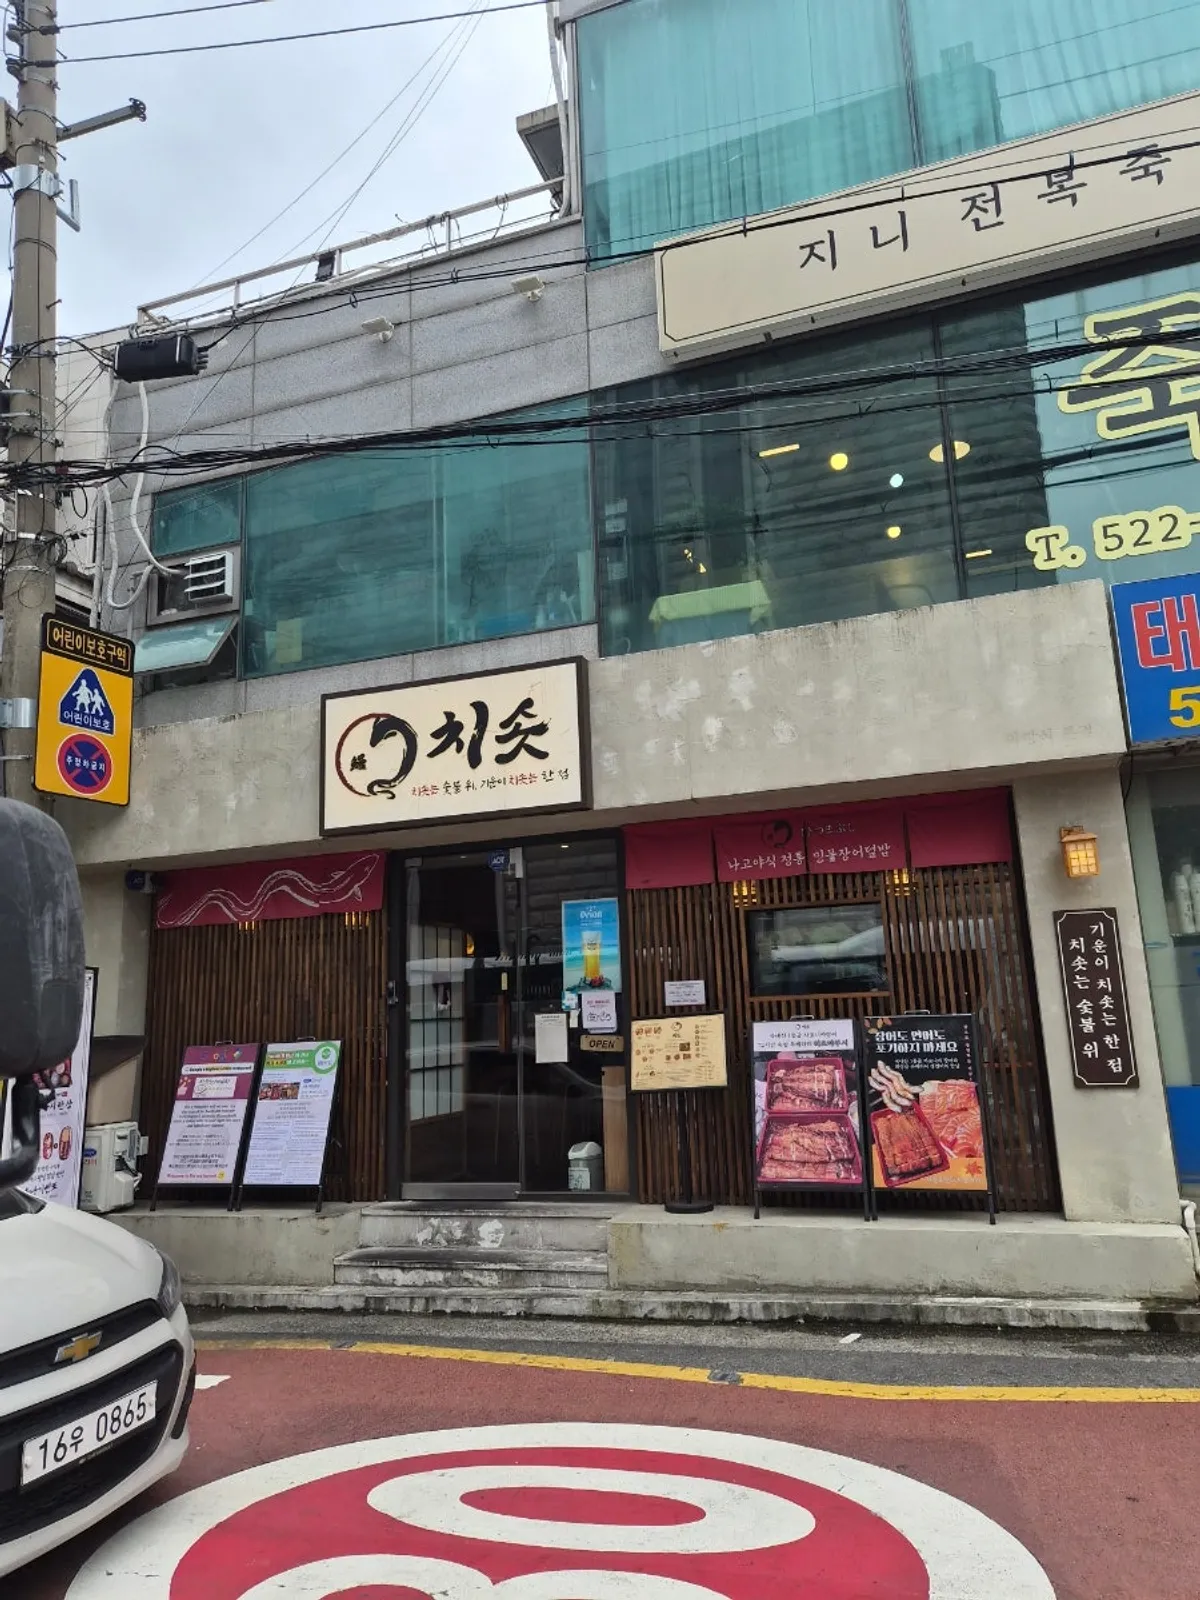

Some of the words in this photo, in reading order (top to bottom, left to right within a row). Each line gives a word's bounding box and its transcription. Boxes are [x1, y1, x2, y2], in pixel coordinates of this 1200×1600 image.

[800, 209, 910, 271] 지니
[960, 142, 1172, 232] 전복죽
[1031, 529, 1082, 567] T.
[52, 626, 127, 667] 어린이보호구역
[63, 709, 111, 731] 어린이보호
[427, 697, 551, 769] 치솟
[66, 755, 106, 772] 주정차금지
[727, 855, 776, 872] 나고야식
[780, 850, 805, 868] 정통
[1069, 937, 1091, 990] 치솟는
[1089, 921, 1109, 971] 기운이
[1076, 998, 1097, 1034] 숯불
[1096, 977, 1117, 1027] 치솟는
[588, 1039, 615, 1050] OPEN
[876, 1041, 920, 1054] 포기하지
[923, 1041, 959, 1053] 마세요
[1082, 1042, 1099, 1059] 위
[1103, 1034, 1121, 1050] 한
[1107, 1057, 1123, 1073] 점
[39, 1425, 84, 1470] 16우
[96, 1392, 147, 1442] 0865
